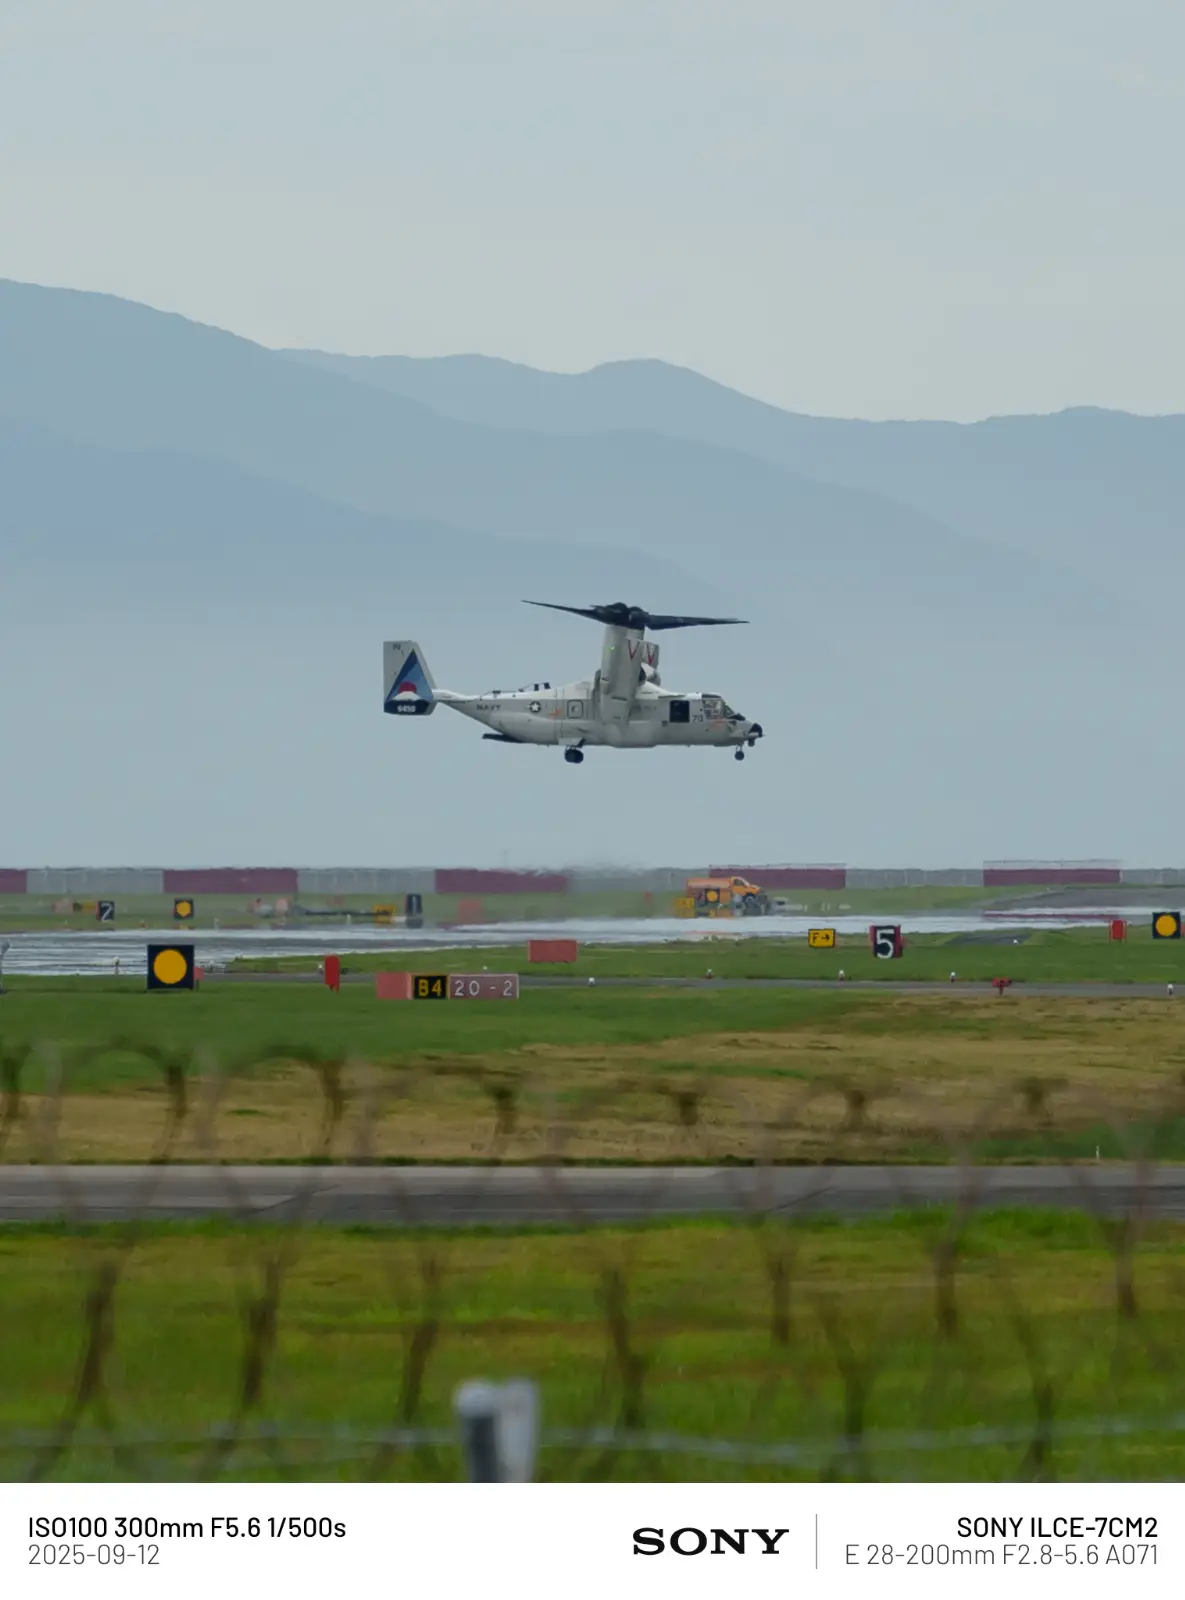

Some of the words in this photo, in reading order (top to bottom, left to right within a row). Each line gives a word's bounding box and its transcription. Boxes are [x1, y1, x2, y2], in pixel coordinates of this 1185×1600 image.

[101, 902, 113, 921] 2
[811, 932, 820, 943] F
[876, 928, 895, 959] 5
[418, 979, 442, 996] B4
